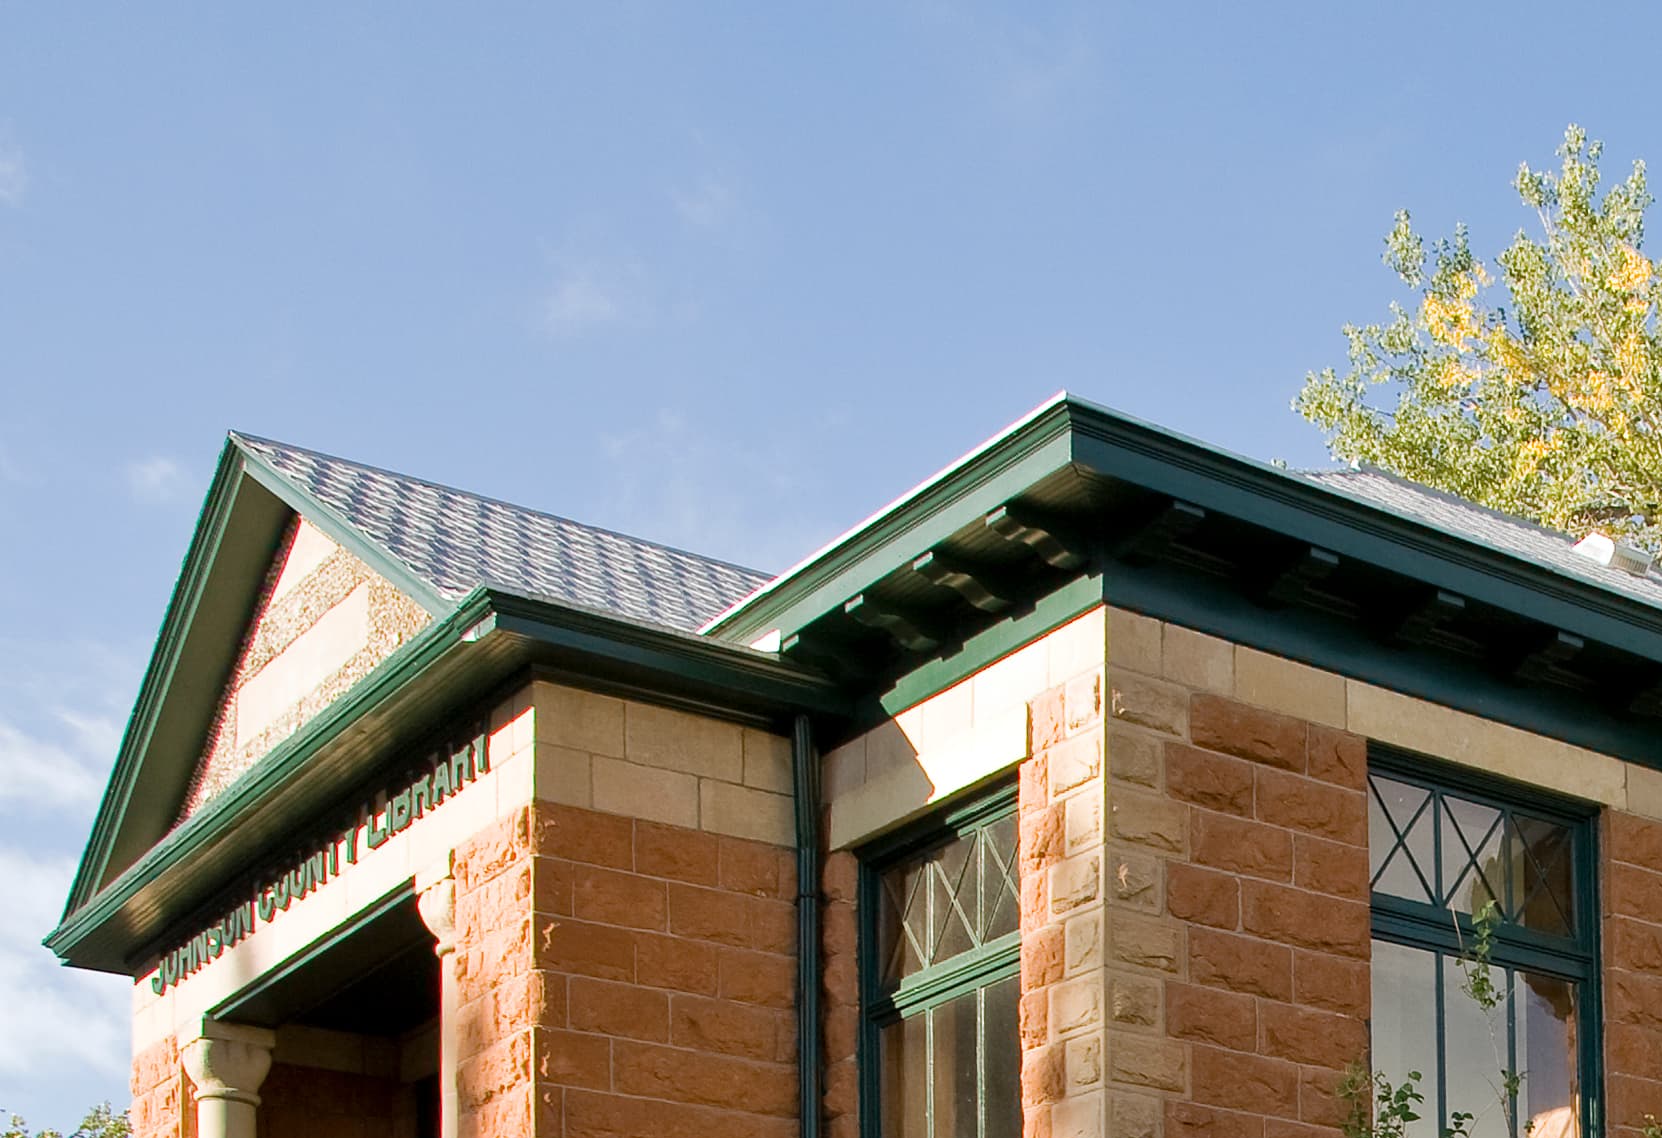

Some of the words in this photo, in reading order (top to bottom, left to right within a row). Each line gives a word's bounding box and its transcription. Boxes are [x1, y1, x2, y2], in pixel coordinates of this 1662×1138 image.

[151, 894, 256, 997] JOHNSON
[257, 818, 363, 923] COUNTY
[365, 728, 491, 850] LIBRARY
